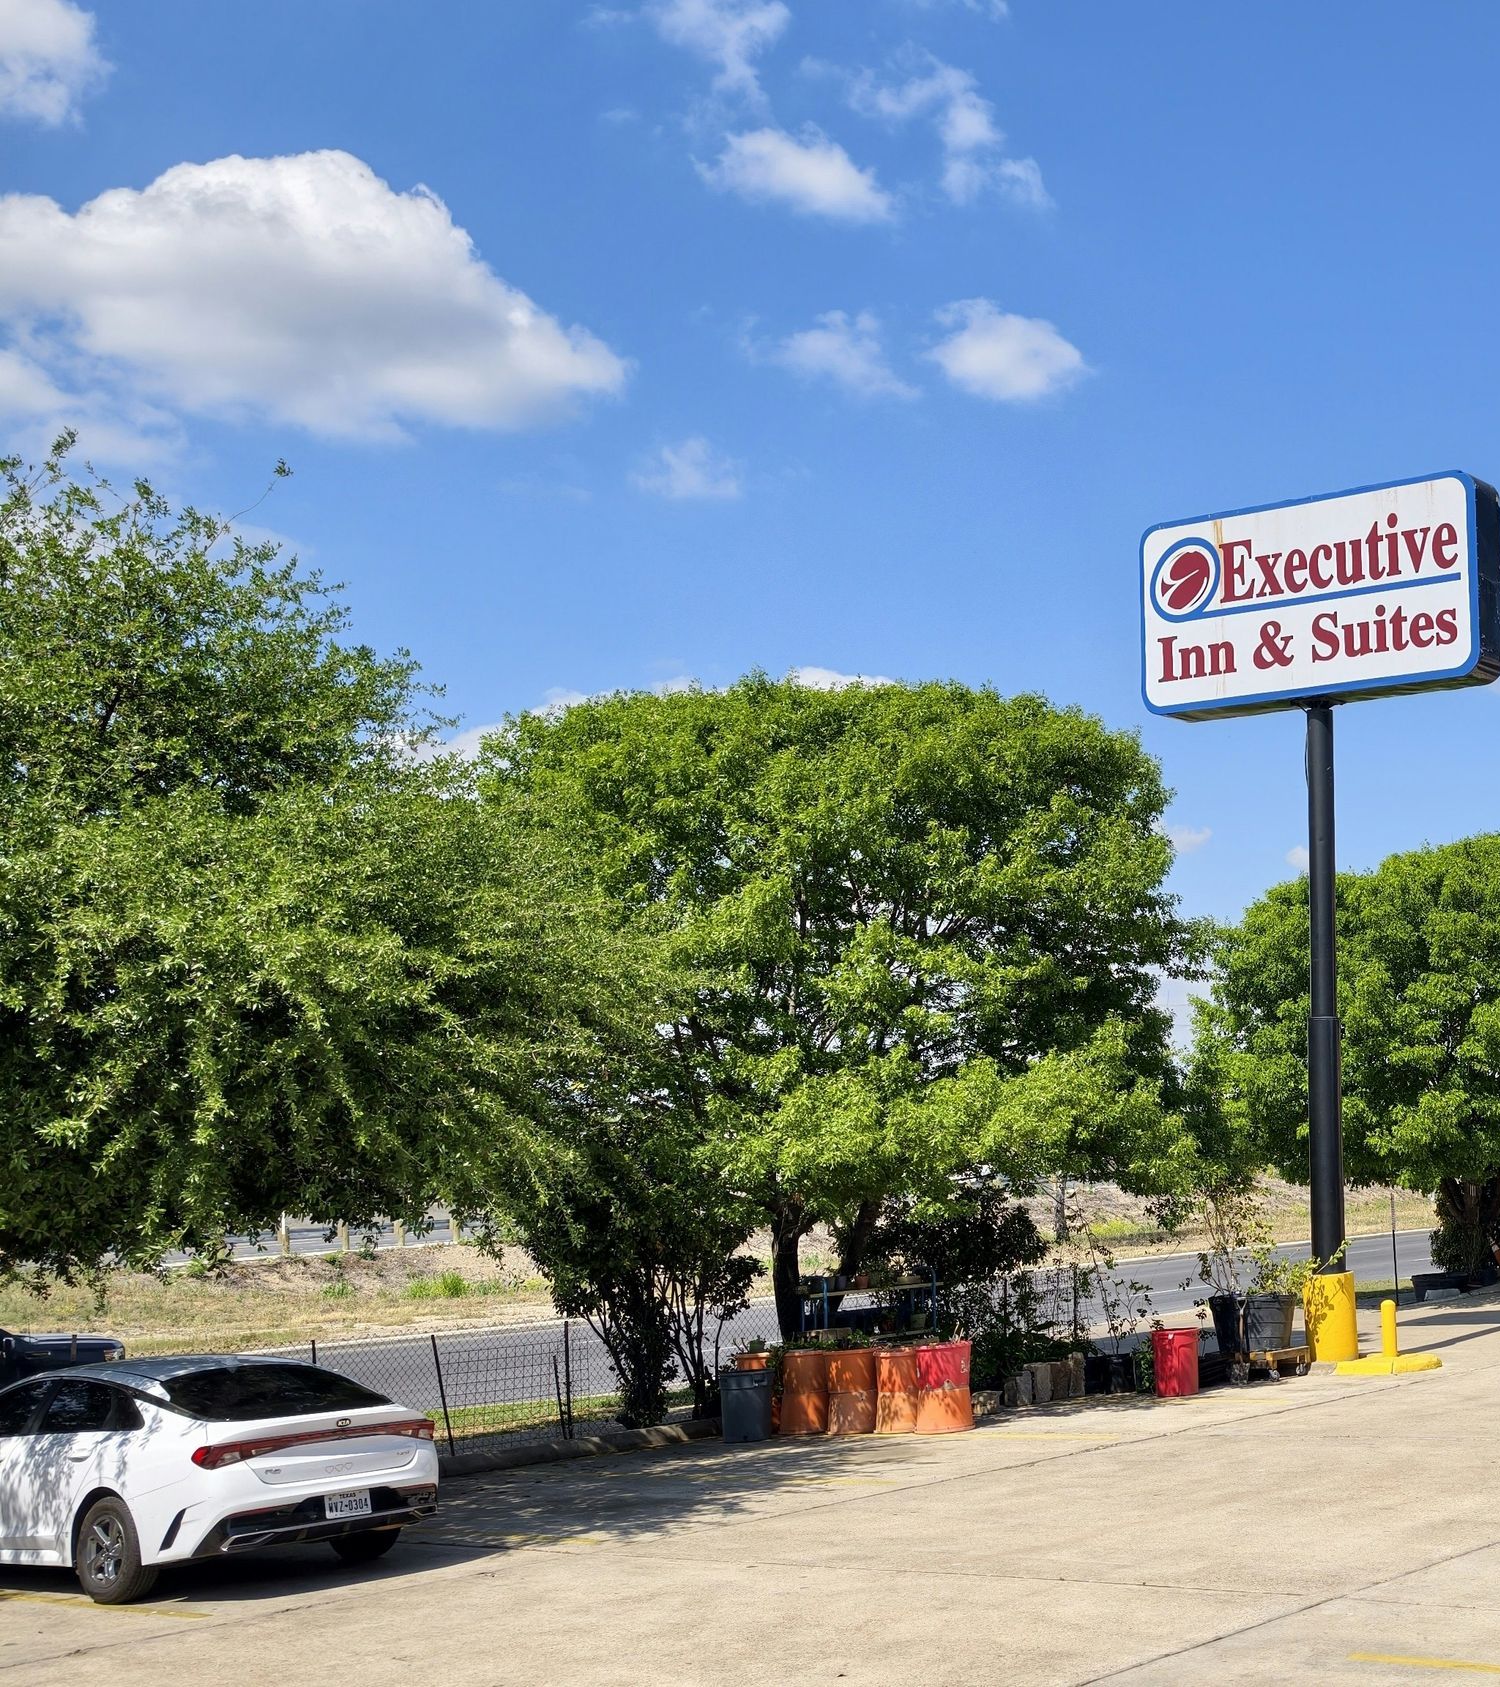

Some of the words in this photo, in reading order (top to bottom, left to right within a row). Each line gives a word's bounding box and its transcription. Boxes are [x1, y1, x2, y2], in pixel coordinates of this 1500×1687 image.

[1219, 512, 1458, 604] Executive
[1157, 636, 1237, 683] Inn
[1253, 620, 1295, 670] &
[1311, 604, 1459, 664] Suites
